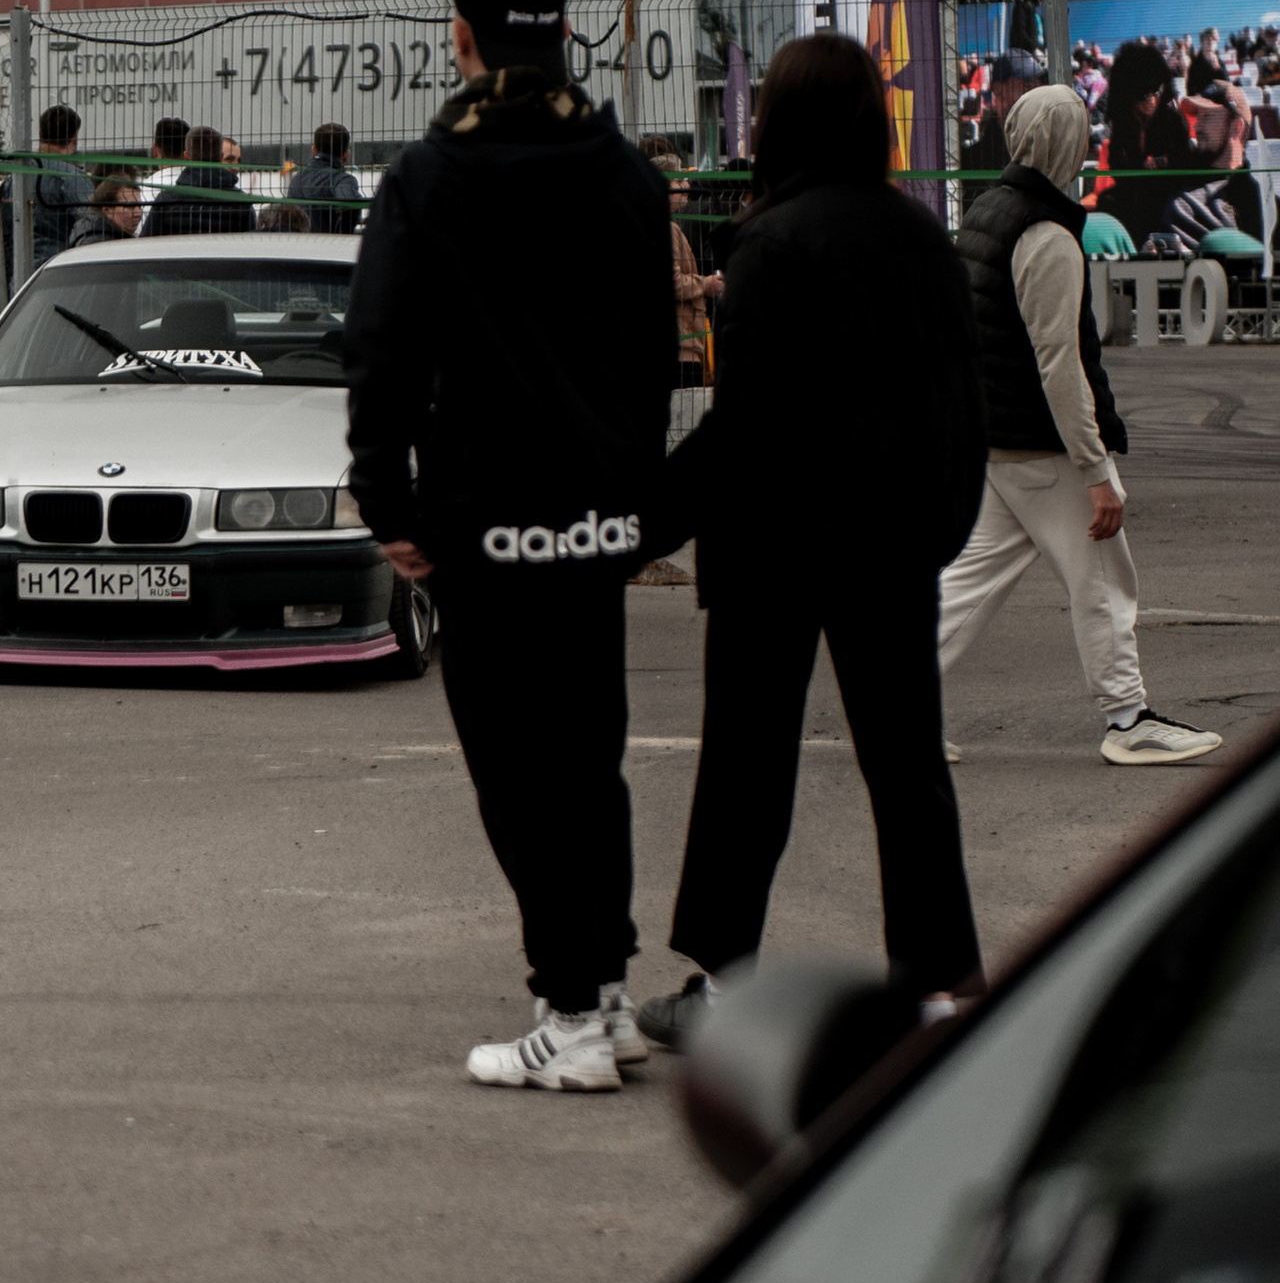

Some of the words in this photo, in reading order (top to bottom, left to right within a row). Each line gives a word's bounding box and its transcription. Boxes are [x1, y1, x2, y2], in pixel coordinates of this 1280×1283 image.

[59, 49, 195, 75] АВТОМОБИЛИ
[140, 566, 181, 588] 136
[150, 589, 171, 597] RUS
